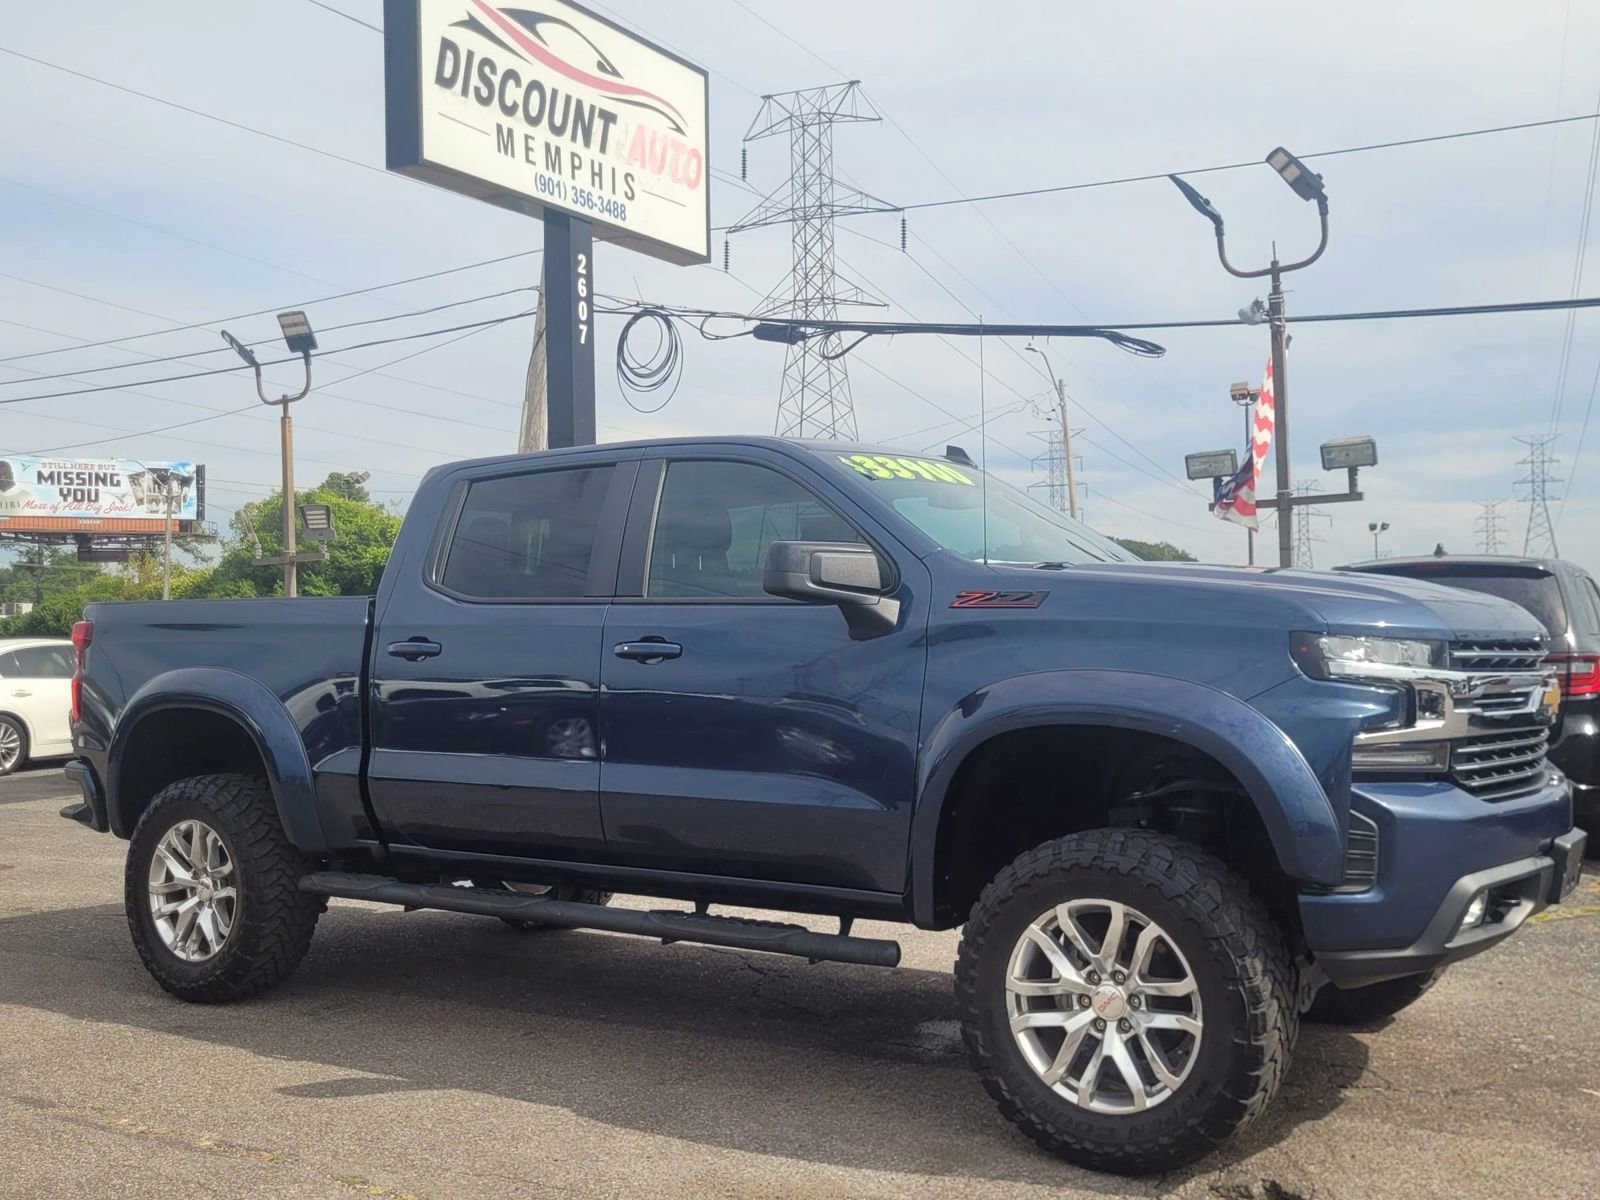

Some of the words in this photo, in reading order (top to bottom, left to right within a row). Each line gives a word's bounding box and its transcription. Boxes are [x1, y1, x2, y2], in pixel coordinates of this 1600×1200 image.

[434, 36, 618, 155] DISCOUNT
[624, 123, 702, 190] AUTO
[496, 122, 636, 201] MEMPHIS
[534, 172, 567, 200] (901)
[571, 187, 627, 221] 356-3488
[577, 253, 588, 344] 2607
[42, 462, 70, 470] STILL
[71, 463, 96, 471] HERE
[97, 463, 117, 471] BUT
[37, 471, 121, 487] MISSING
[59, 487, 99, 503] YOU
[49, 500, 61, 513] of
[84, 501, 102, 515] Big
[1098, 991, 1119, 1013] GMC
